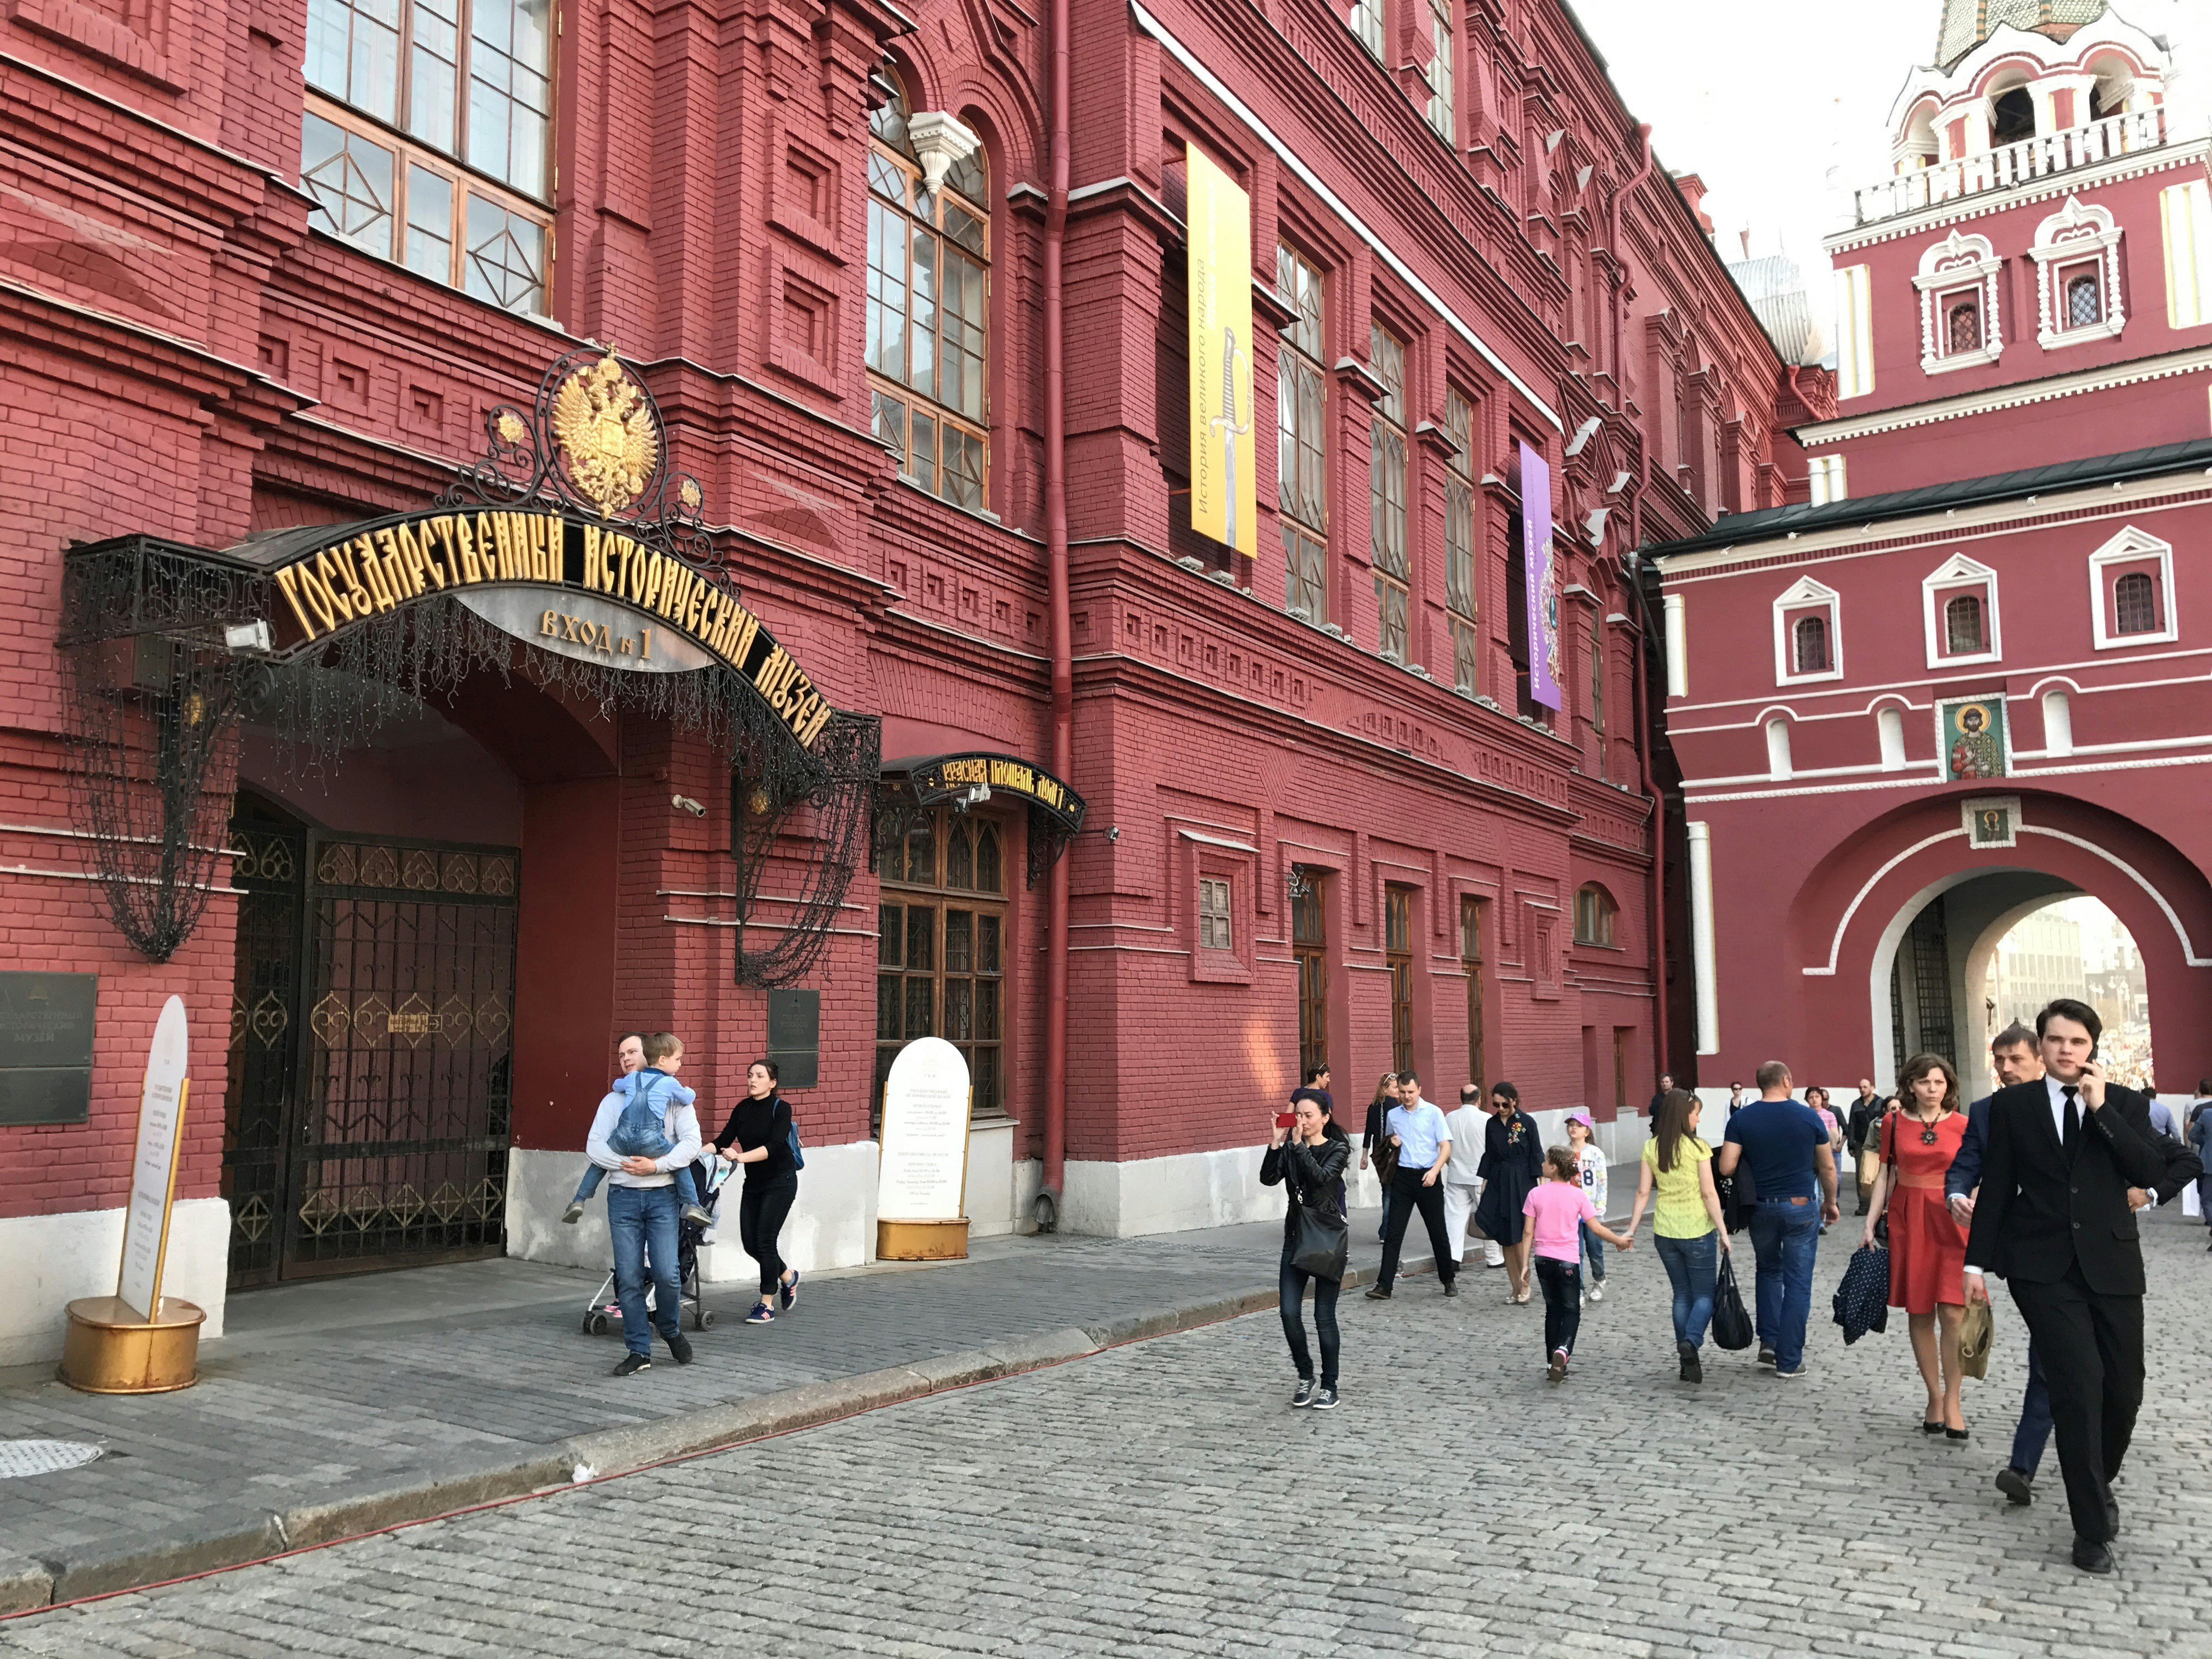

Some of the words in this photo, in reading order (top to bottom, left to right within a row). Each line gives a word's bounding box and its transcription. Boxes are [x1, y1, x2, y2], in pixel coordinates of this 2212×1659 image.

[1197, 258, 1206, 330] народа
[1197, 335, 1207, 426] великого
[1198, 431, 1209, 515] История
[274, 508, 563, 642] ГОСУДАРСТВЕННЫЙ
[583, 524, 760, 670] ИСТОРИЧЕСКИЙ
[754, 642, 832, 749] МУЗЕЙ
[540, 609, 614, 657] ВХОД
[641, 628, 652, 661] 1
[1529, 572, 1540, 690] Исторический
[1583, 1170, 1593, 1186] 8
